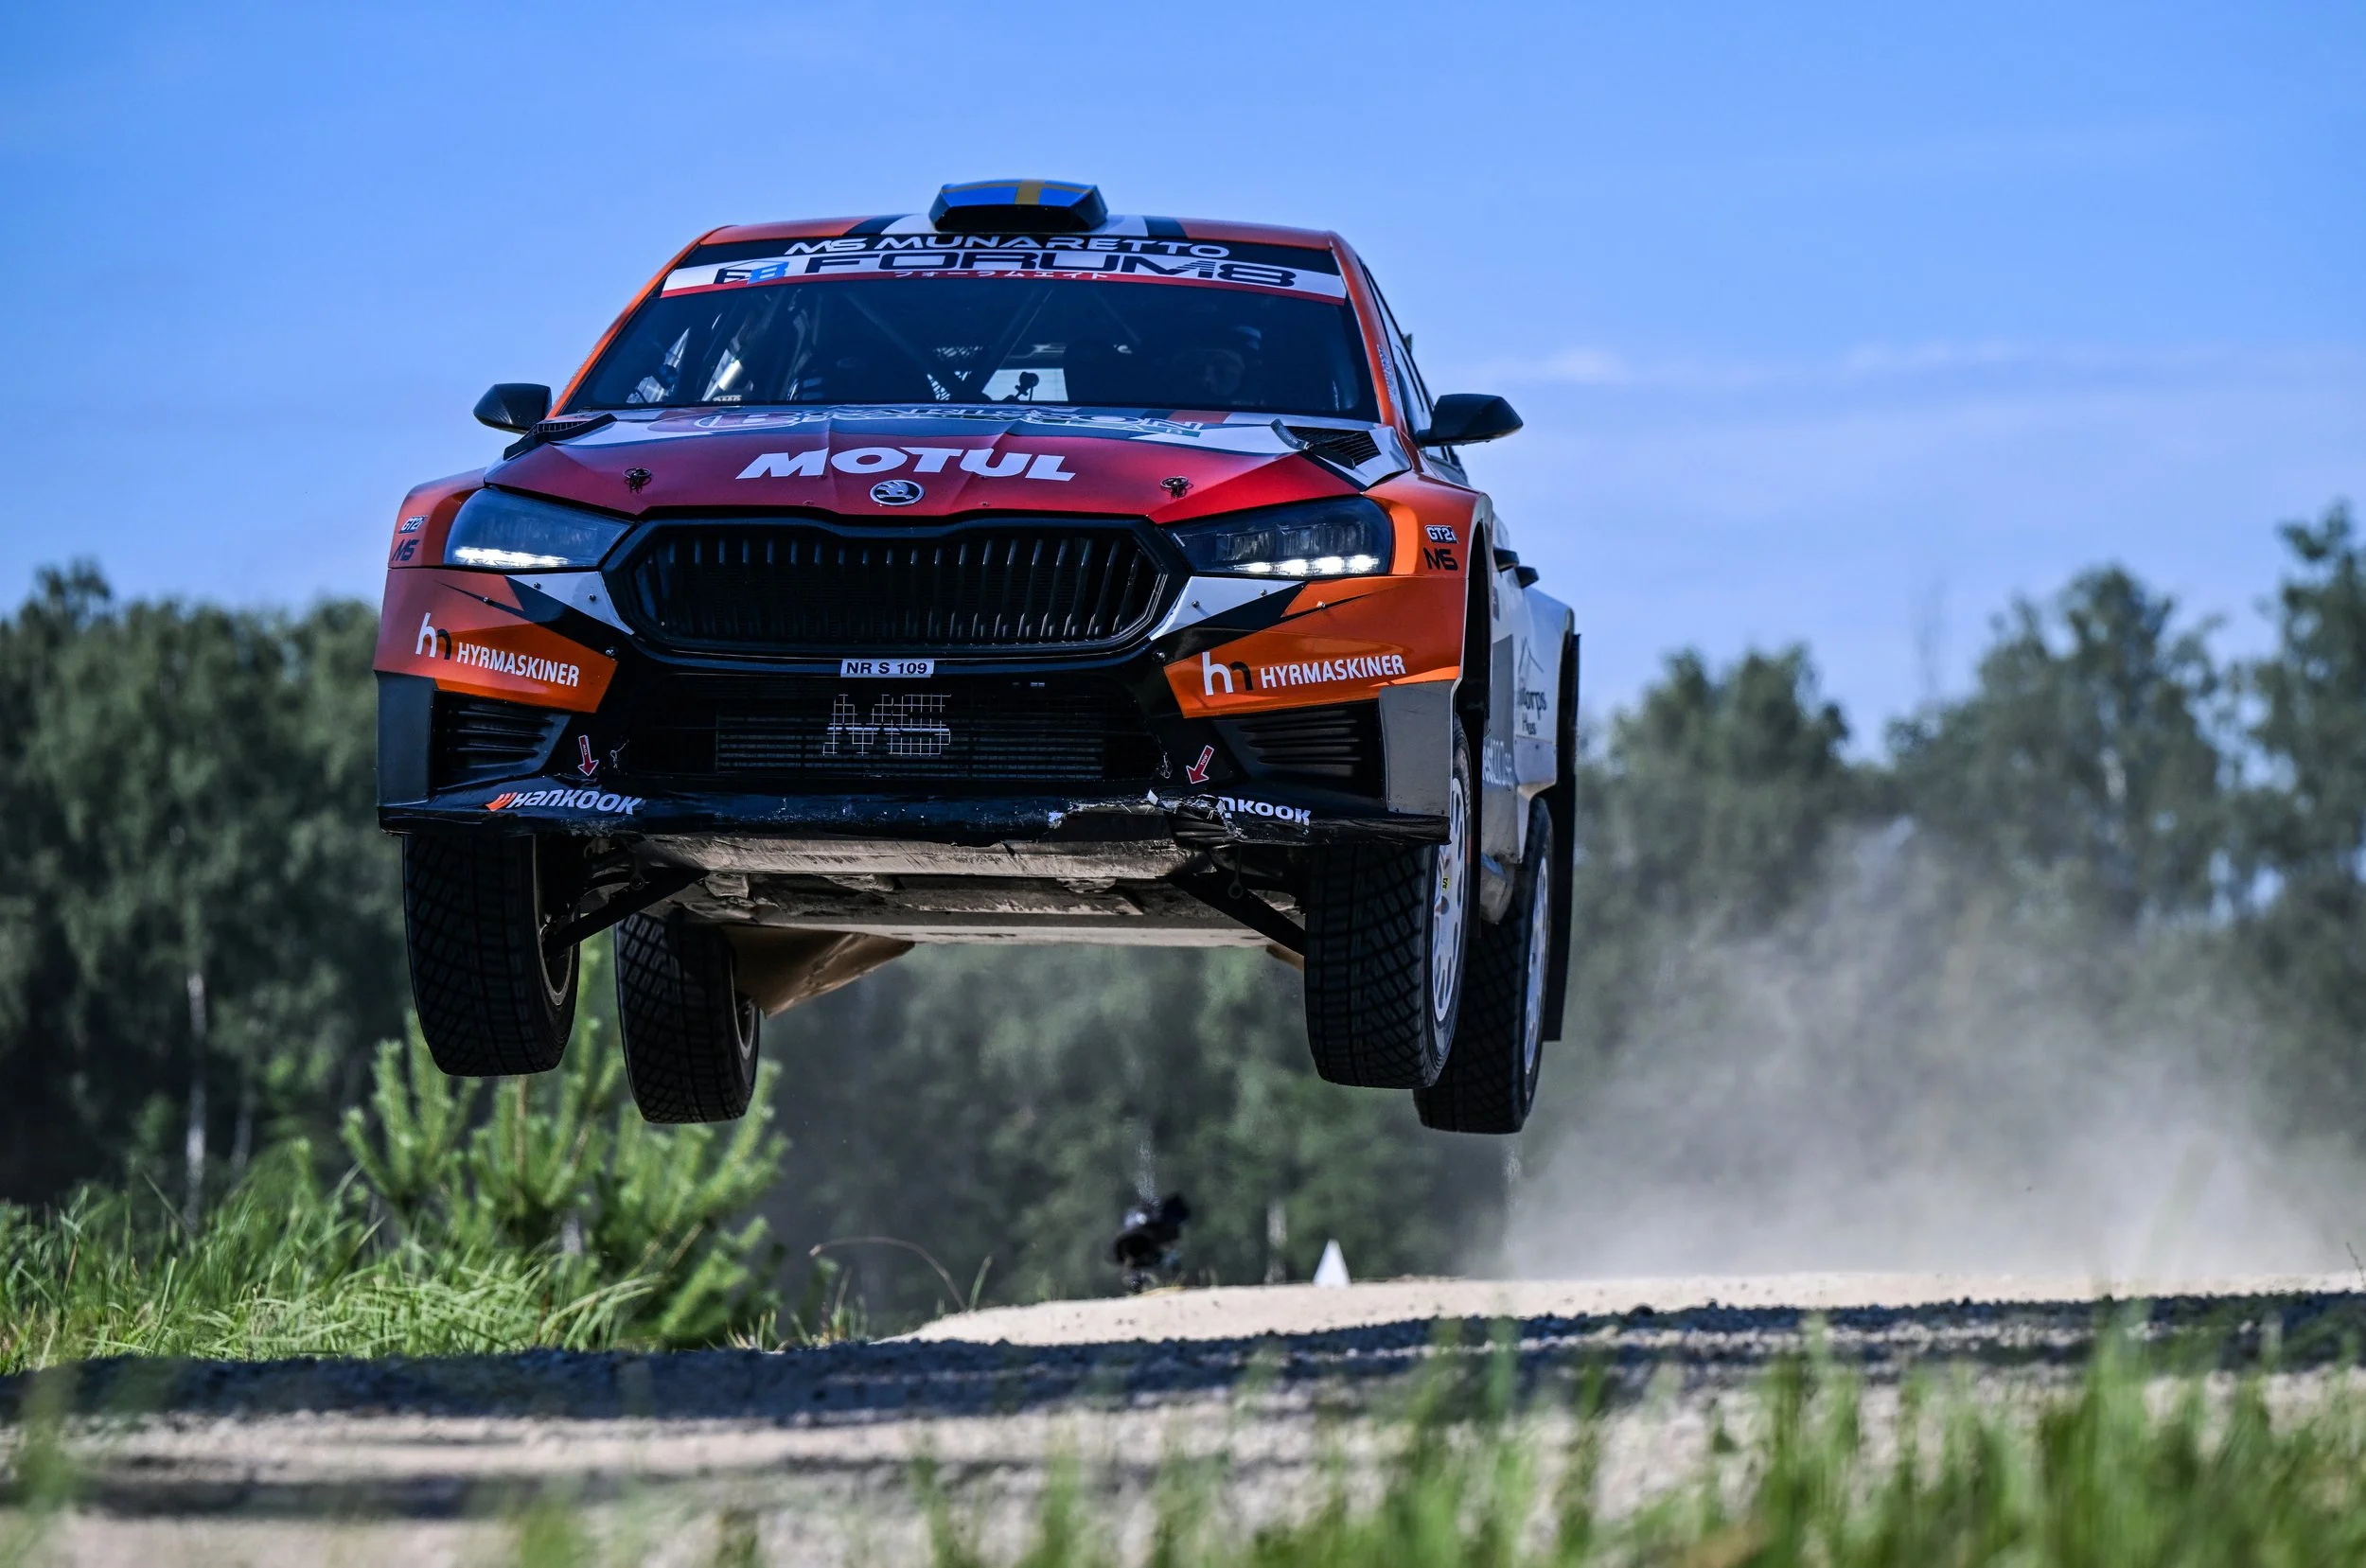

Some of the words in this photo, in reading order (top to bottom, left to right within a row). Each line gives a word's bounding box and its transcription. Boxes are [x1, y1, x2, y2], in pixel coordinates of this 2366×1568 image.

[784, 238, 868, 255] MS
[875, 236, 1230, 257] MUNARETTO
[804, 252, 1297, 288] FORUM8
[735, 447, 1076, 482] MOTUL
[1423, 547, 1458, 570] MS
[456, 642, 580, 687] HYRMASKINER
[846, 662, 873, 674] NR
[878, 662, 890, 674] S
[897, 662, 927, 675] 109
[1261, 654, 1406, 689] HYRMASKINER
